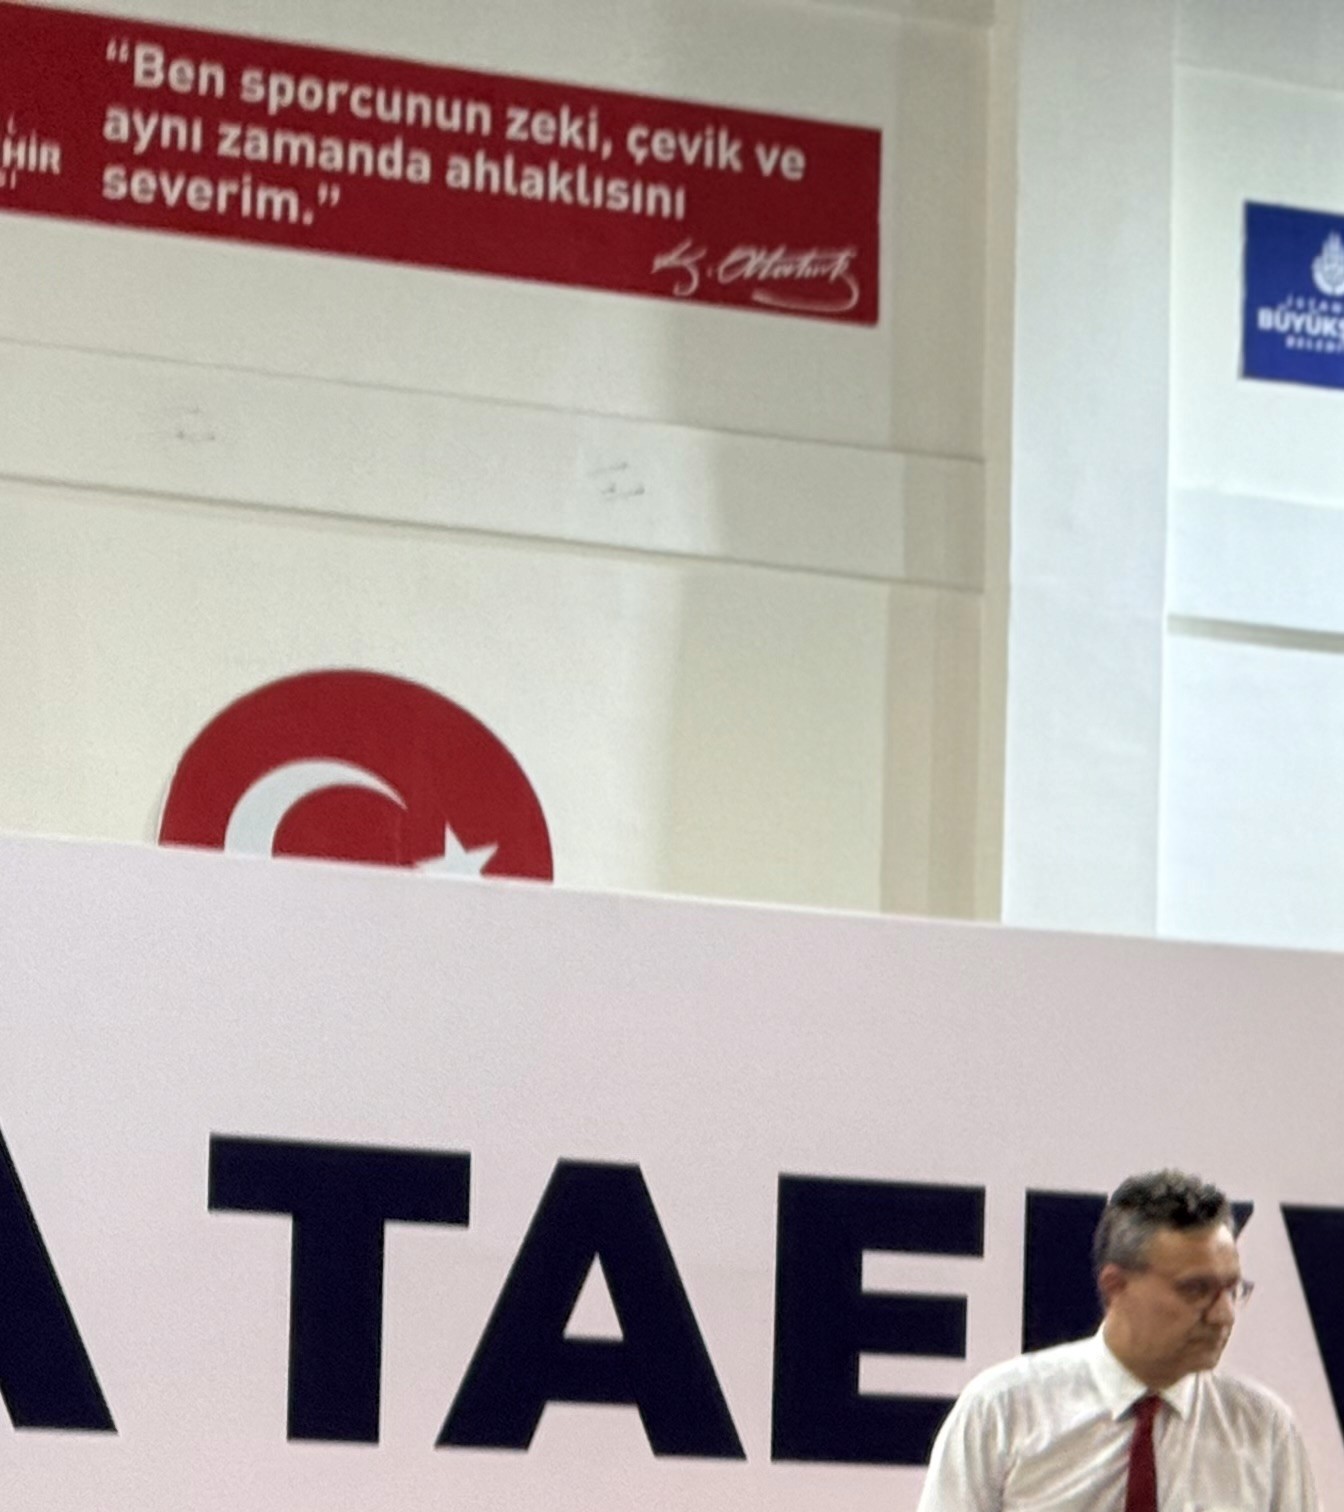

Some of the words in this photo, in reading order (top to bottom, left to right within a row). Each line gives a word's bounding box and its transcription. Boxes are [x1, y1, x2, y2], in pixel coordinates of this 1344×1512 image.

[103, 105, 203, 156] aynı
[217, 120, 432, 185] zamanda
[445, 147, 687, 221] ahlaklısını
[105, 38, 225, 99] “Ben
[240, 67, 491, 138] sporcunun
[505, 104, 613, 160] zeki,
[627, 123, 743, 172] çevik
[755, 142, 807, 181] ve
[102, 163, 341, 227] severim.”
